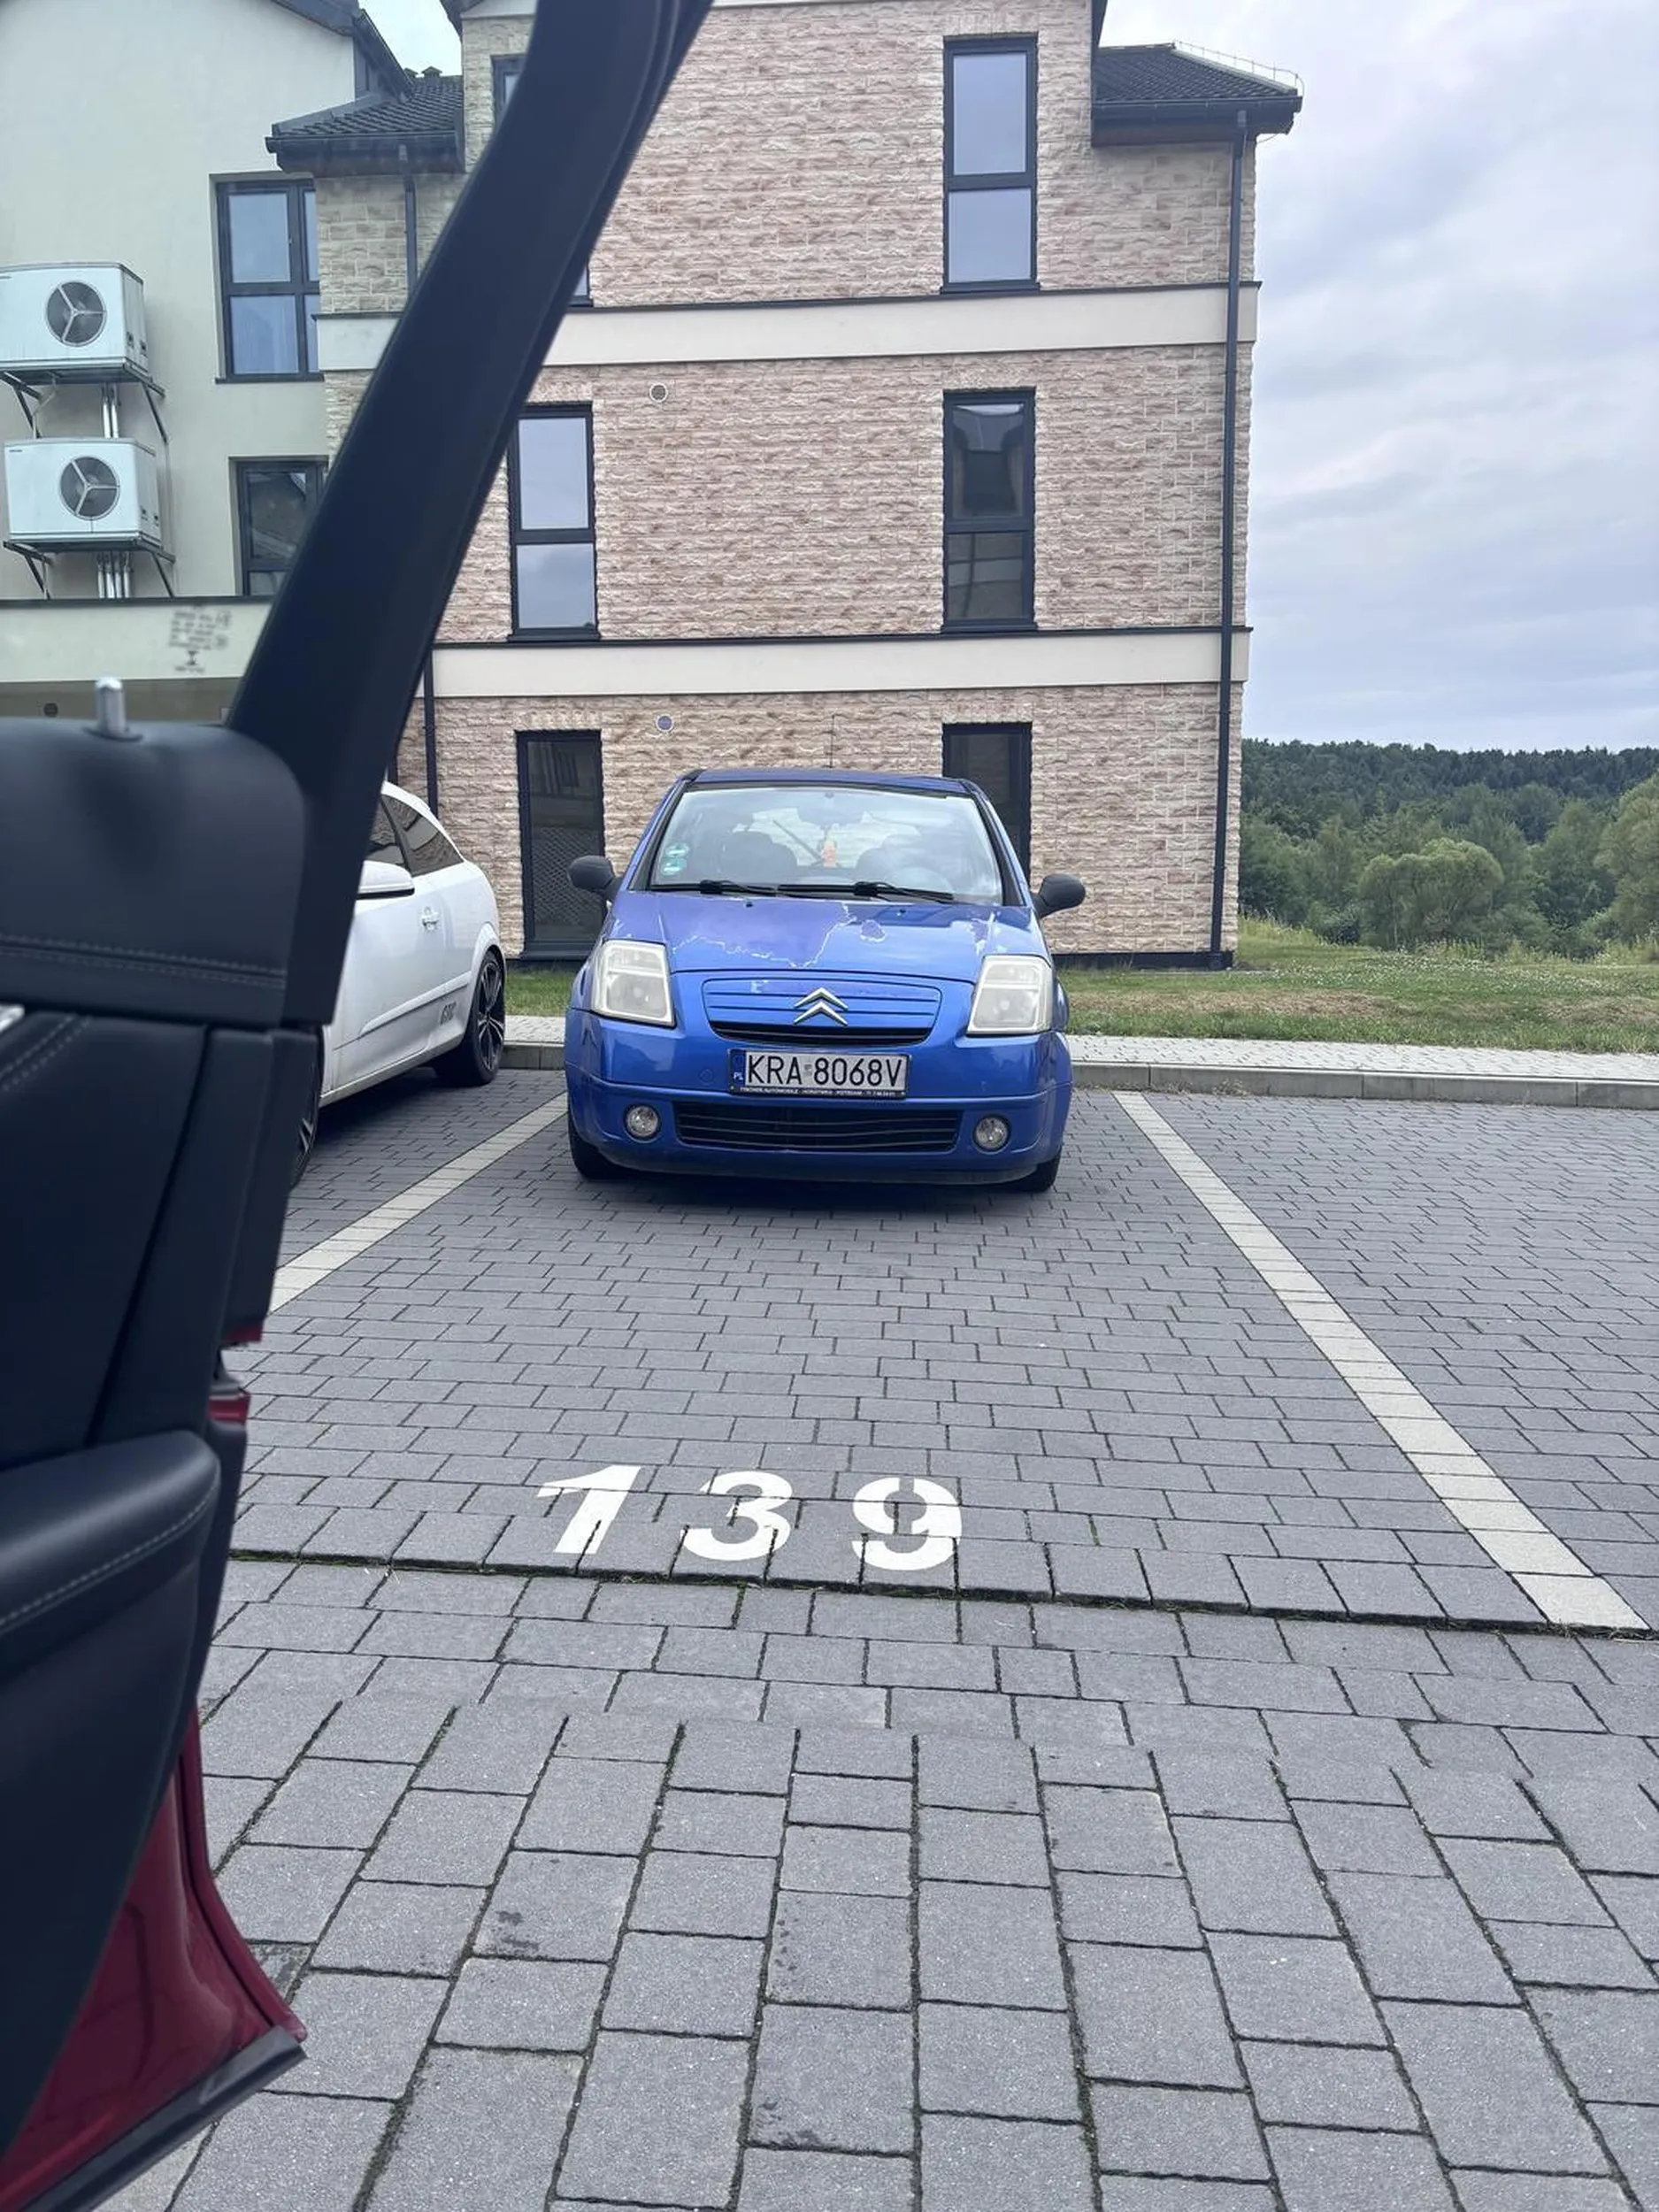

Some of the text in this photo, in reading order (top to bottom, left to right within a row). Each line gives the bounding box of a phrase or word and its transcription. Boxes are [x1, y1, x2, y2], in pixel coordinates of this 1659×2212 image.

[749, 1056, 902, 1087] KRA 8068V
[536, 1464, 964, 1571] 139
